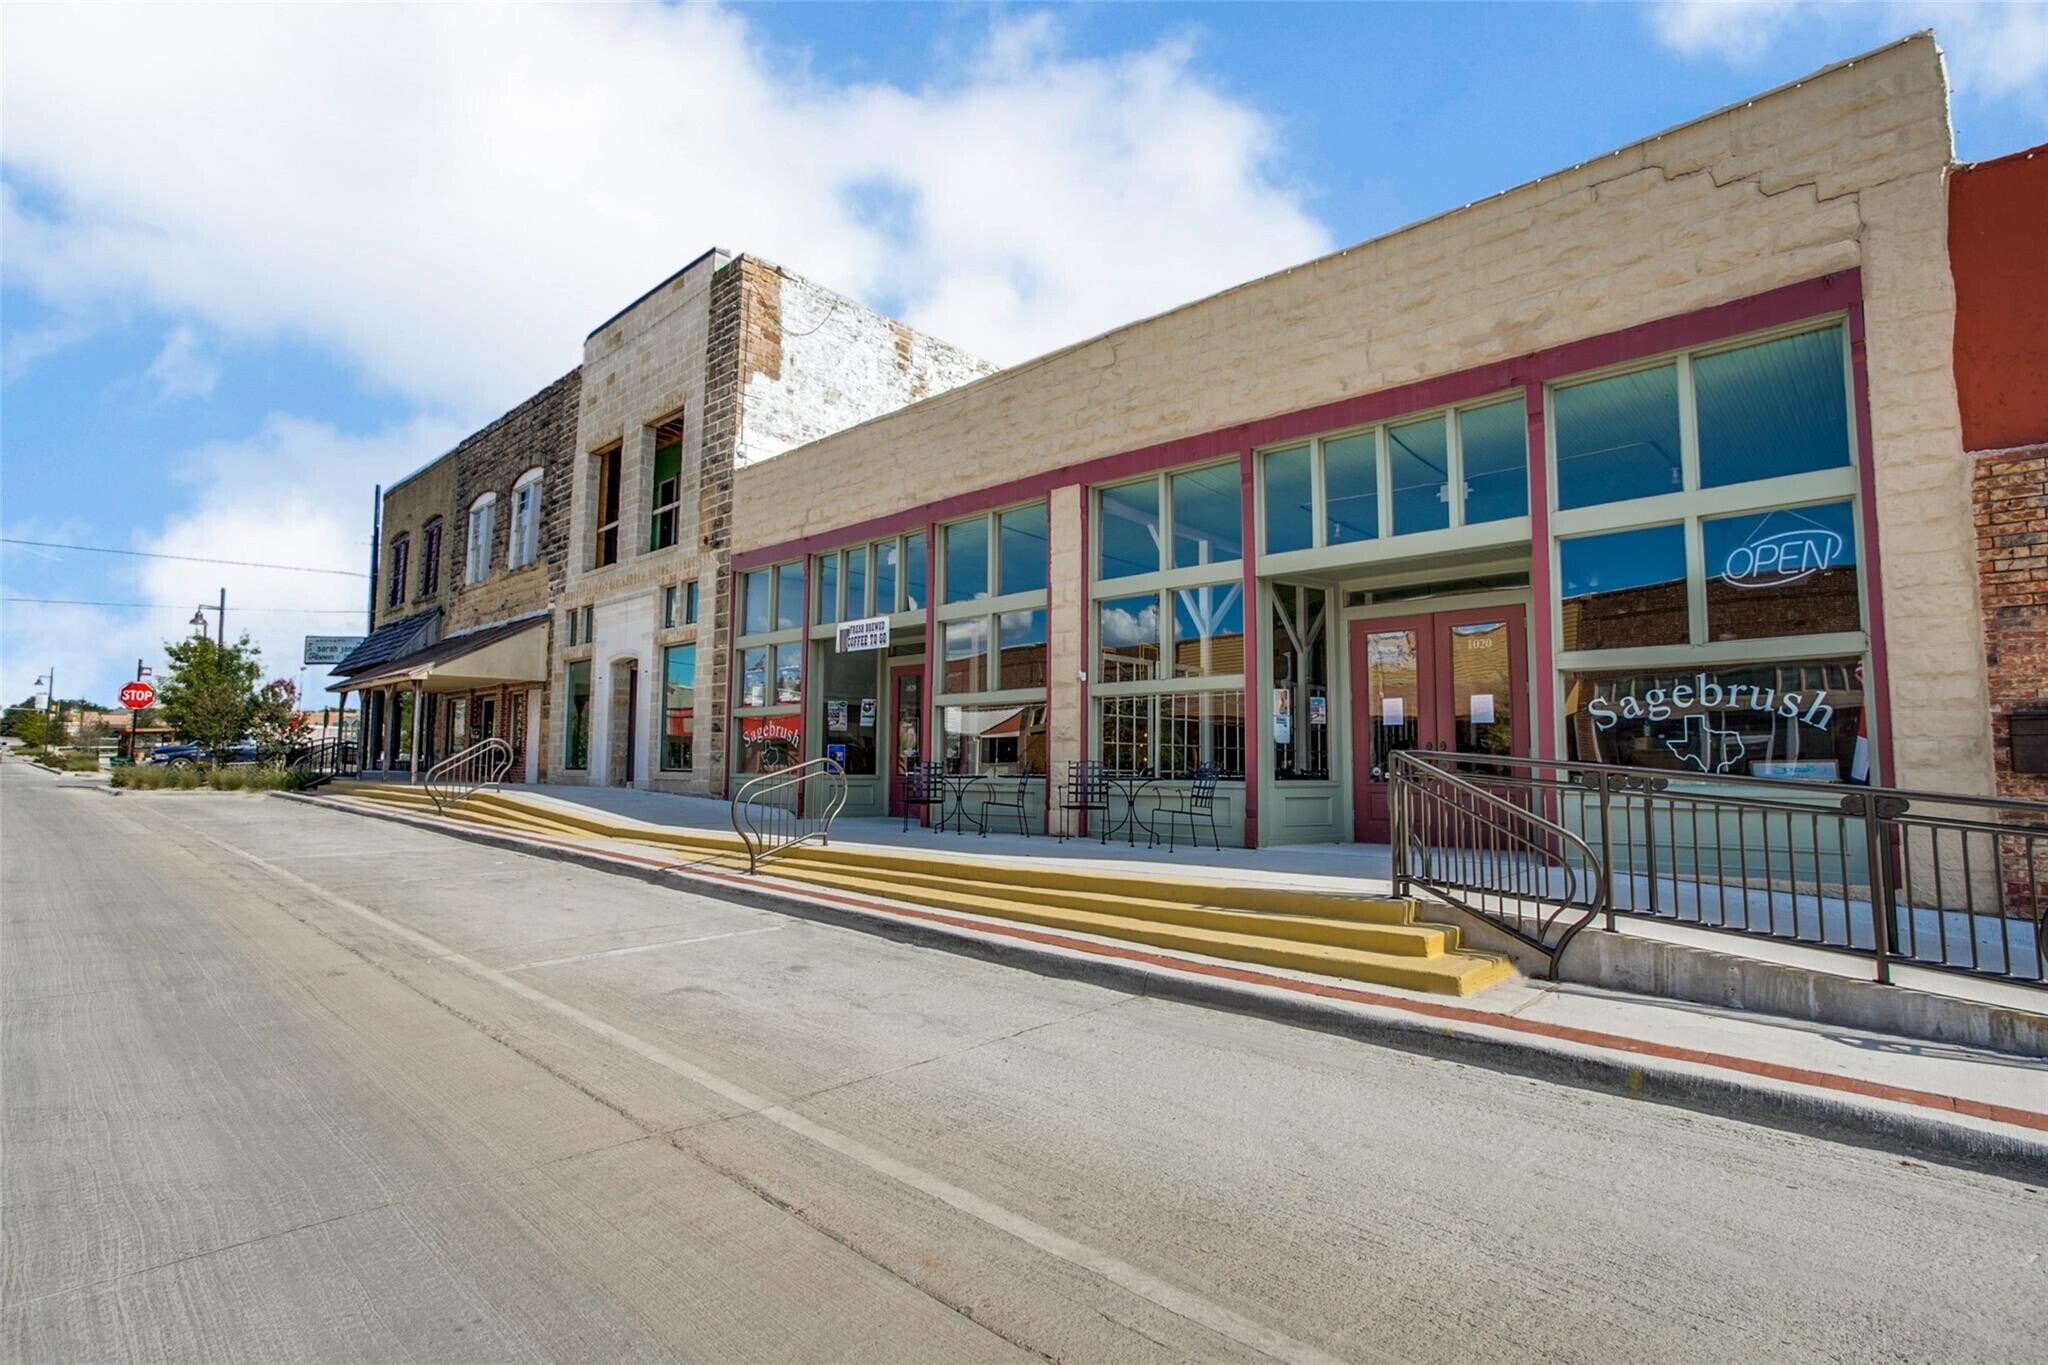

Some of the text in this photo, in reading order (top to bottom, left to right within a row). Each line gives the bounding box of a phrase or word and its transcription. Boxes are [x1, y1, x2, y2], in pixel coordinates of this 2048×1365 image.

[1726, 537, 1832, 579] OPEN
[850, 624, 864, 634] FRESH
[848, 632, 887, 647] COFFEE TO GO
[1467, 638, 1493, 649] 1020
[121, 689, 153, 701] STOP
[1587, 672, 1835, 731] Sagebrush
[743, 720, 799, 748] Sagebrush
